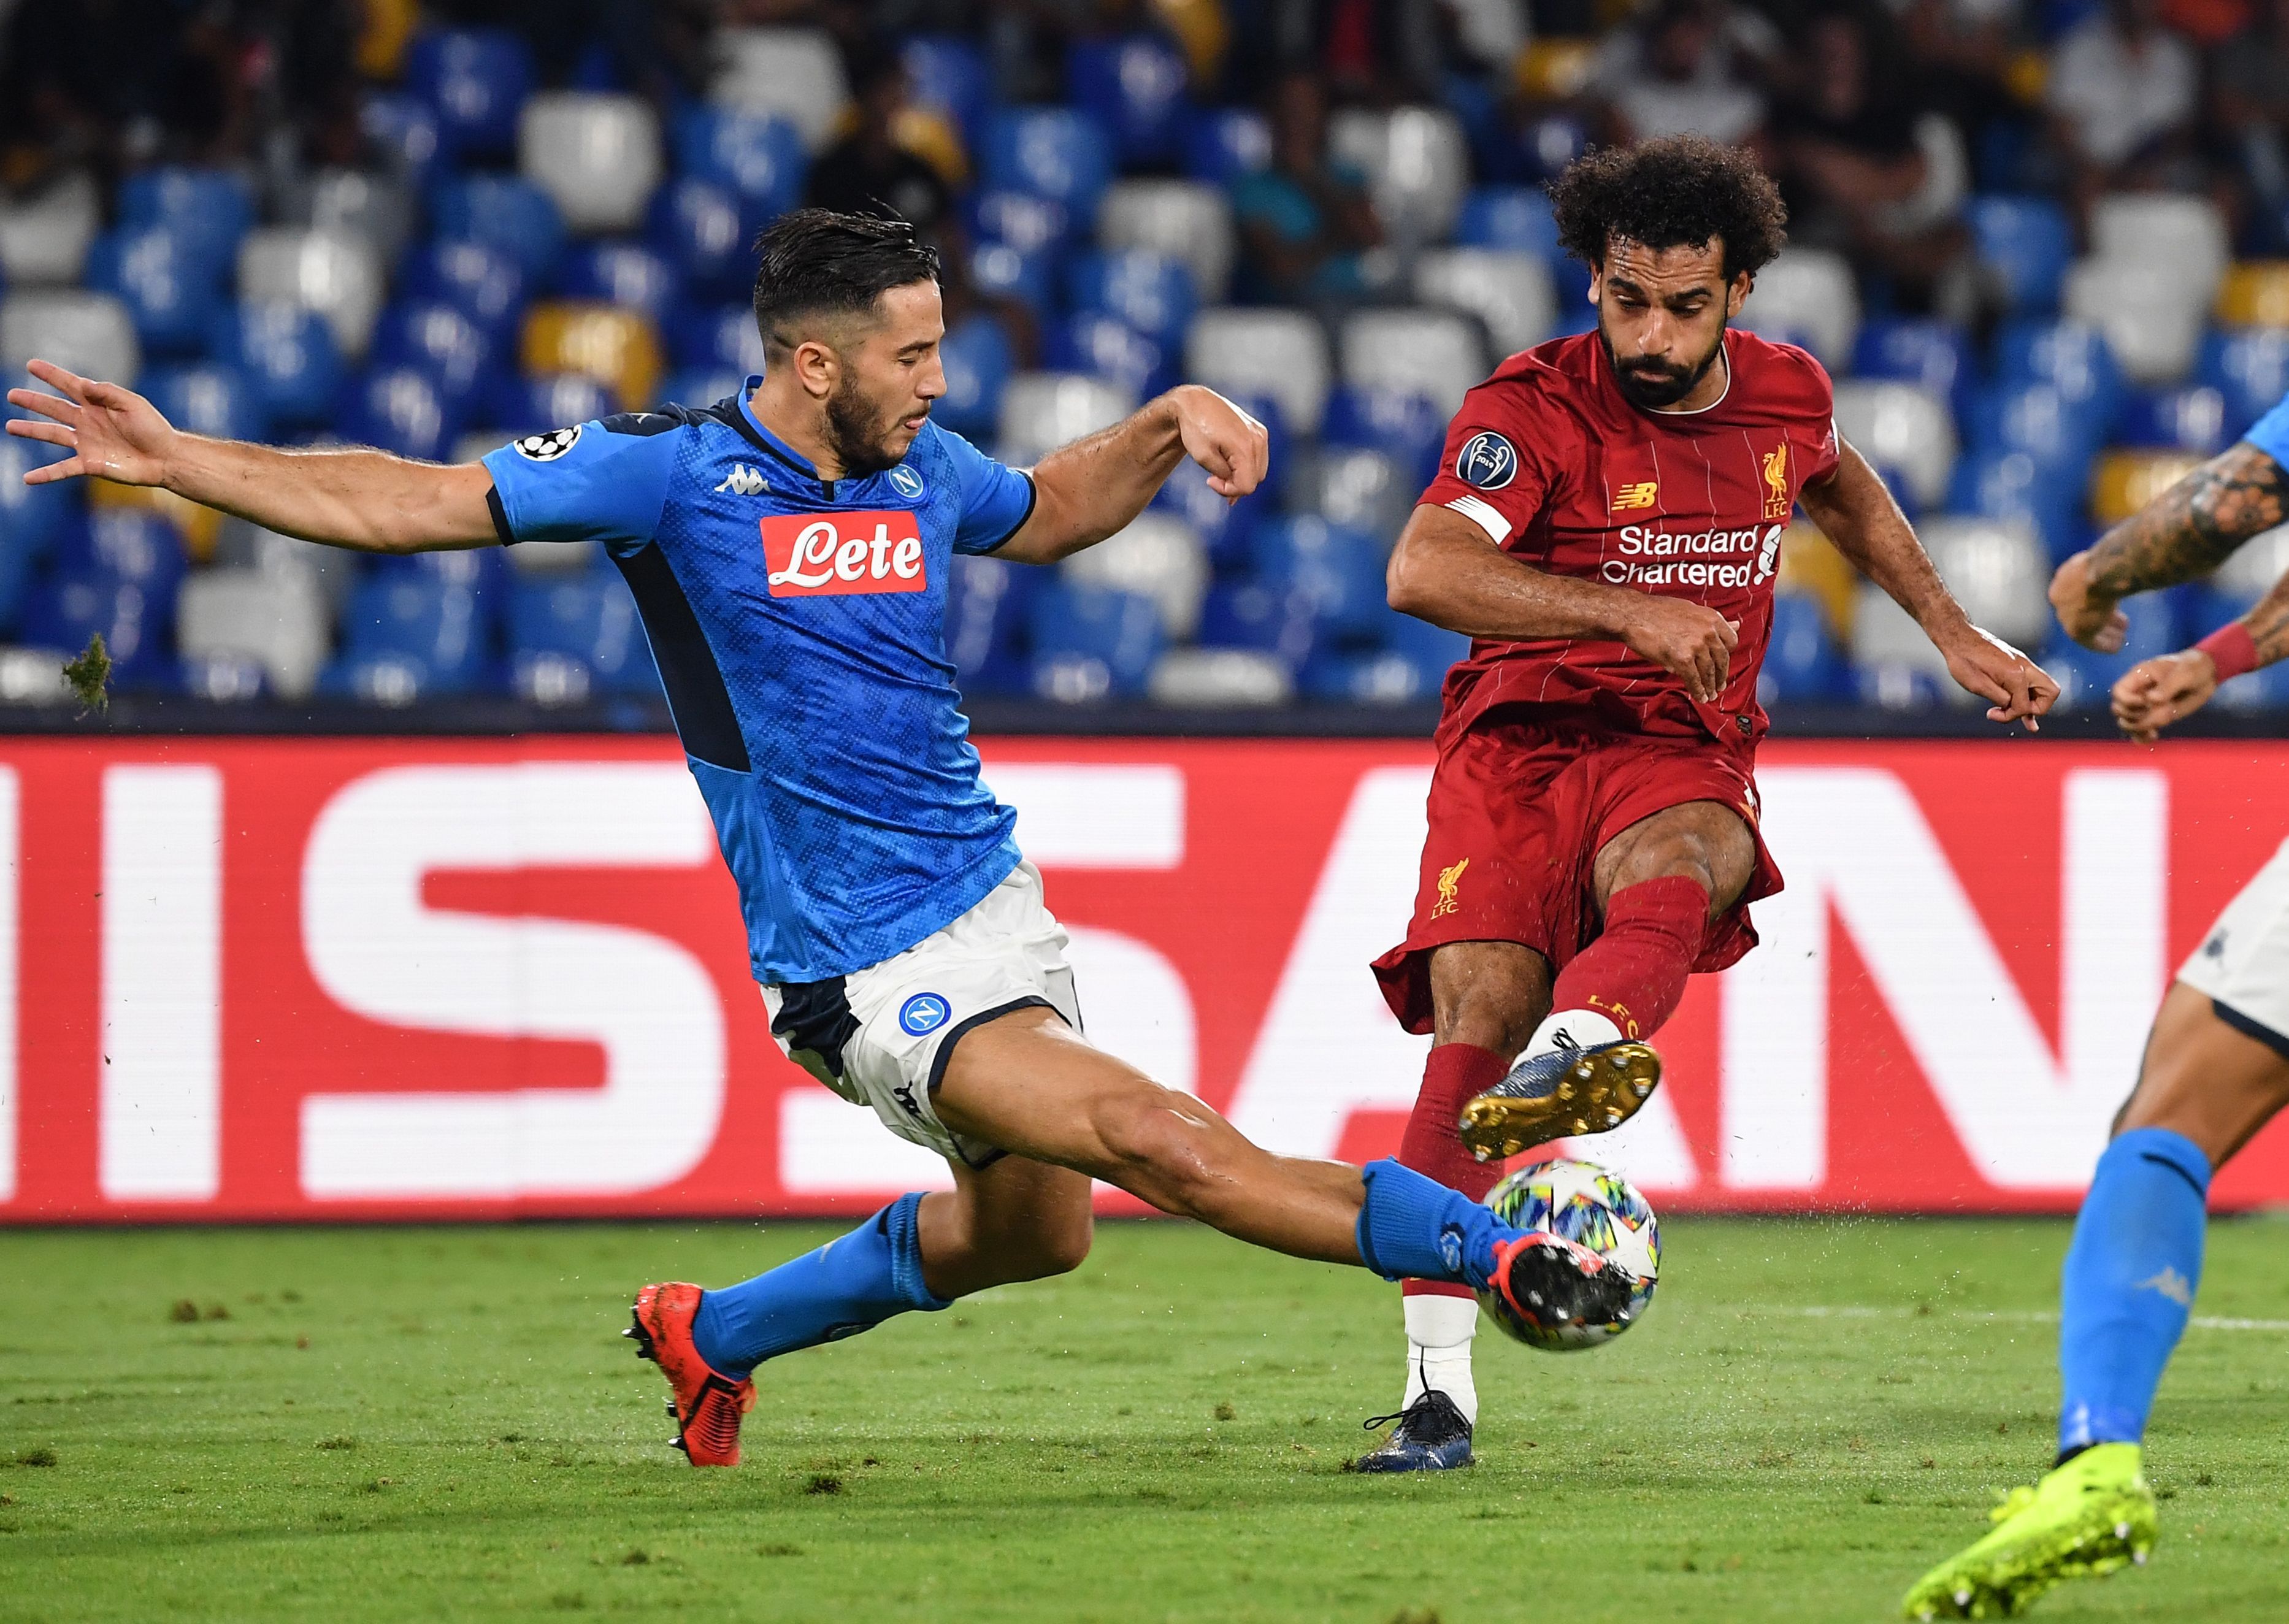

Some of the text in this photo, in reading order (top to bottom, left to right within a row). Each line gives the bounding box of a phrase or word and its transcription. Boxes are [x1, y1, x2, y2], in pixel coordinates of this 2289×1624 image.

[1475, 455, 1495, 469] 2019
[892, 469, 919, 493] N
[768, 521, 921, 588] Lete
[1618, 525, 1759, 556] Standard
[1601, 559, 1753, 588] Chartered
[0, 762, 2169, 1203] ISAN
[909, 1000, 940, 1027] N
